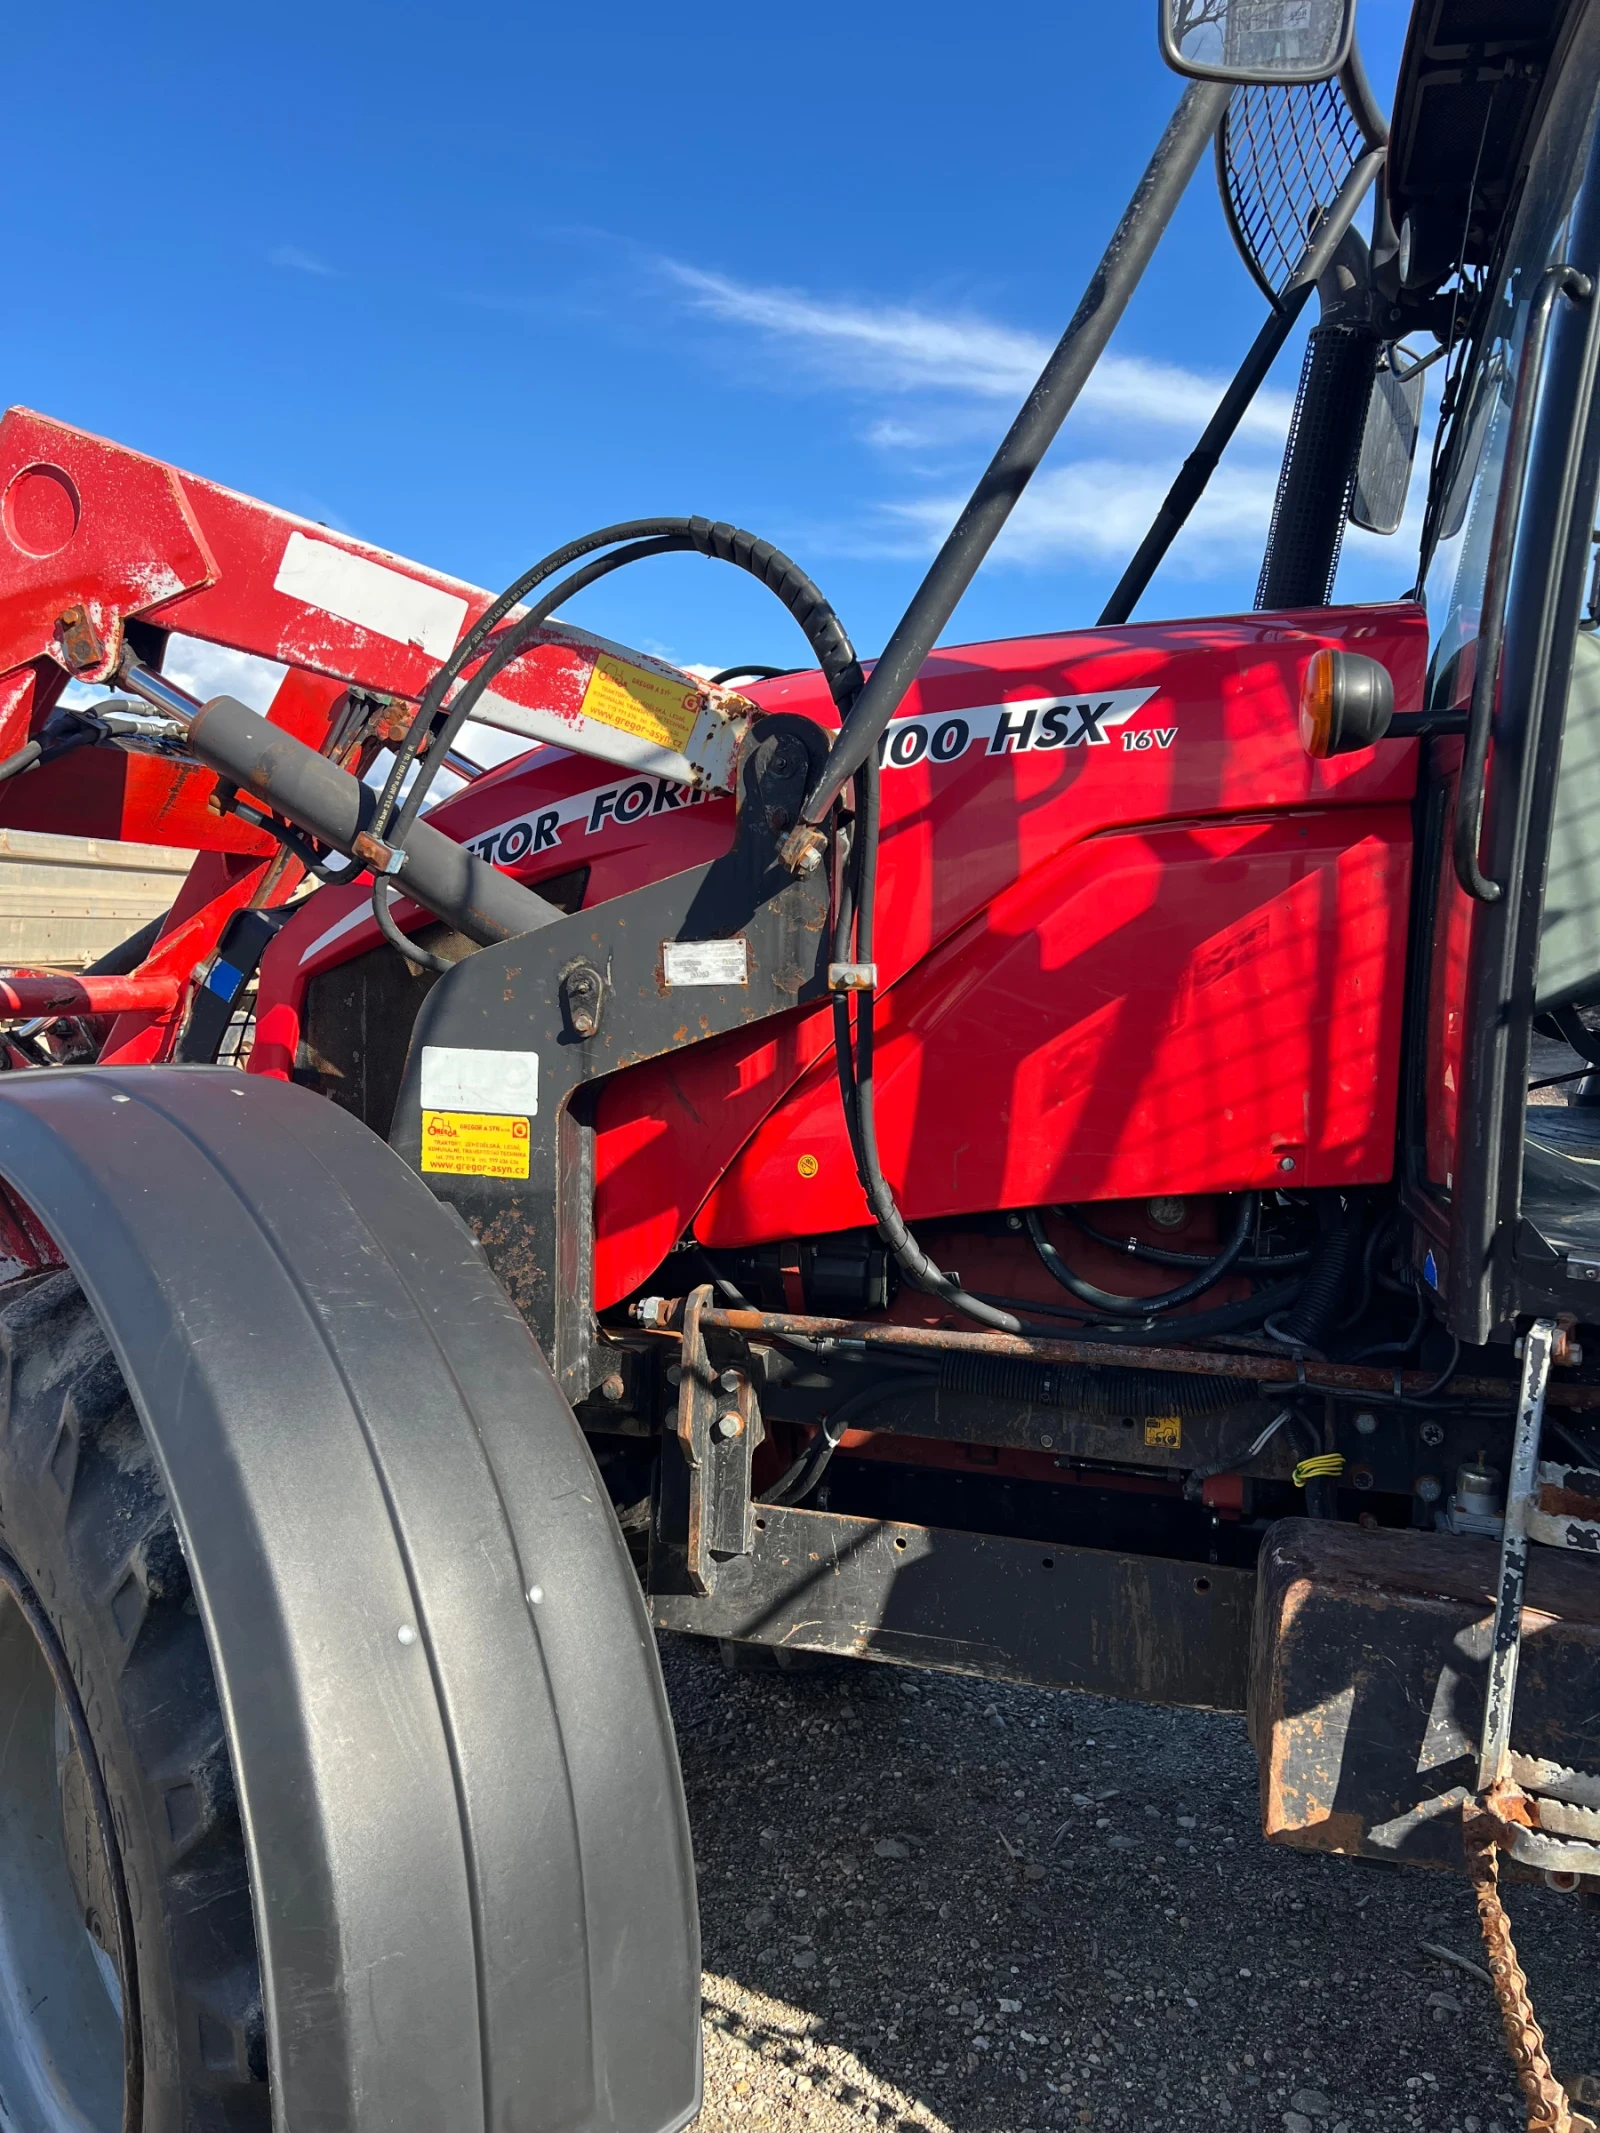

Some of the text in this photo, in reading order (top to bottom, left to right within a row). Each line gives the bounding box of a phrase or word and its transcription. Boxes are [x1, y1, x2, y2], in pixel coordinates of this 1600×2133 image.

[482, 619, 494, 631] ISO
[502, 598, 513, 609] EN
[631, 677, 655, 691] GREGOR
[590, 706, 684, 749] www.gregor-asyn.cz
[989, 701, 1115, 754] HSX
[1123, 728, 1178, 751] 16V
[379, 808, 389, 821] bar
[388, 780, 400, 796] MPa
[466, 810, 561, 864] TOR
[460, 1123, 483, 1131] GREGOR
[430, 1160, 525, 1174] www.gregor-asyn.cz
